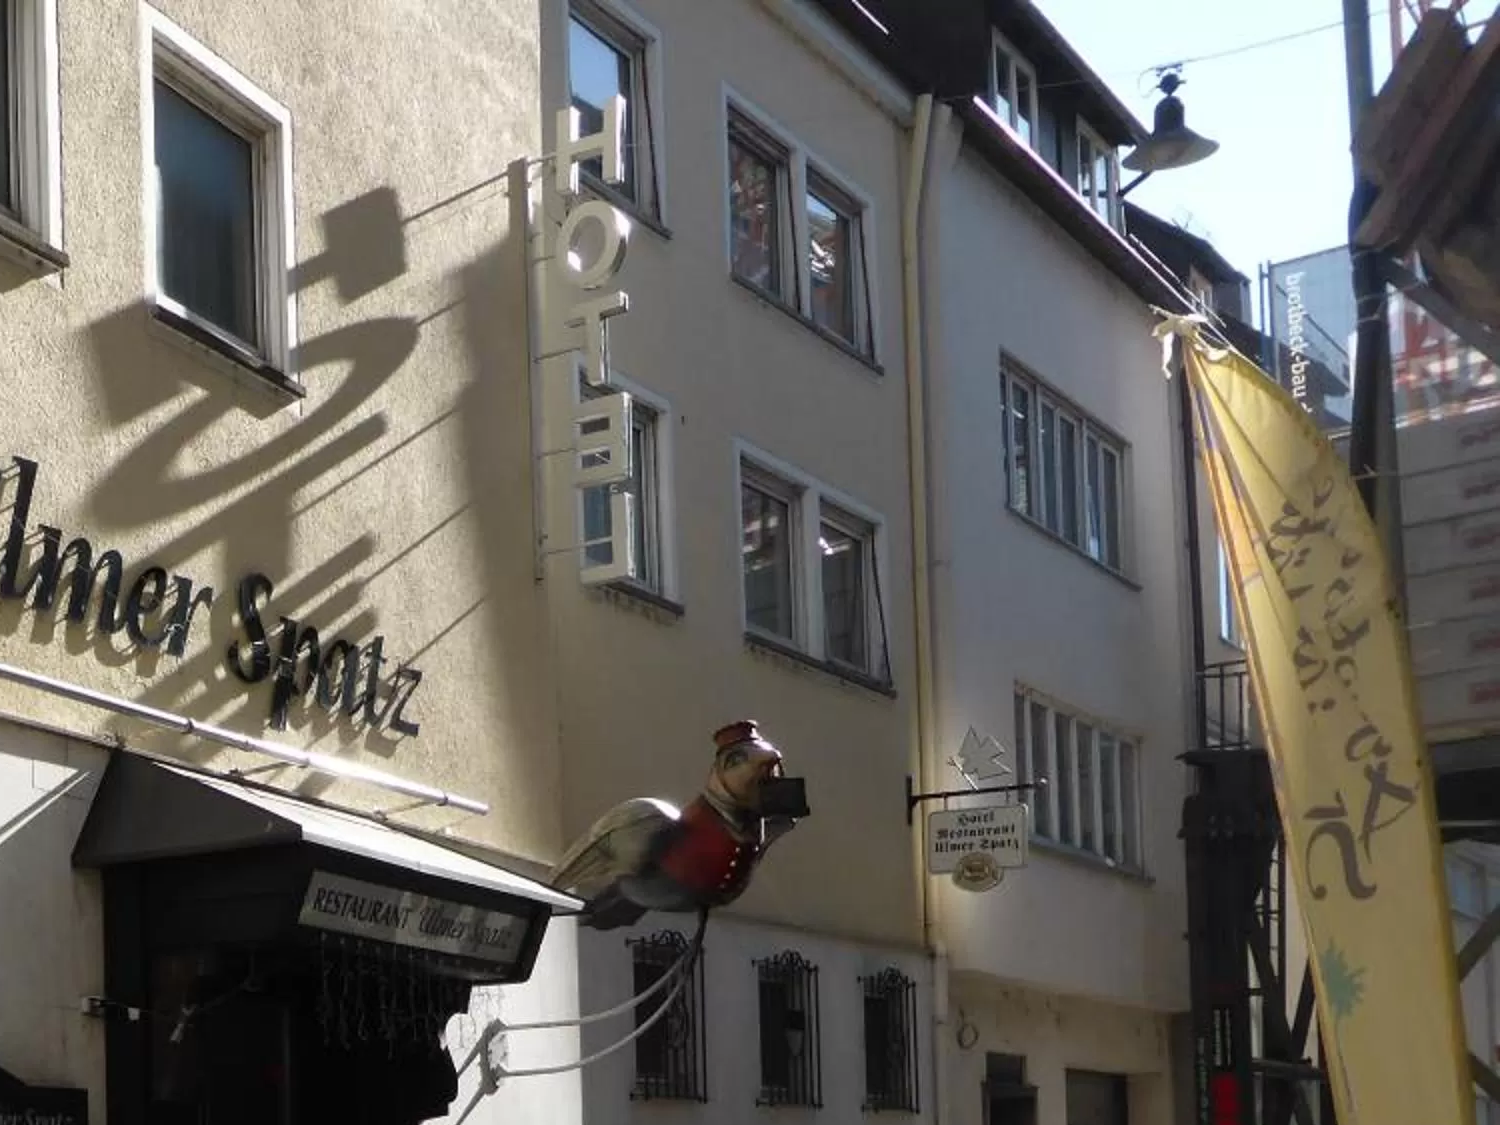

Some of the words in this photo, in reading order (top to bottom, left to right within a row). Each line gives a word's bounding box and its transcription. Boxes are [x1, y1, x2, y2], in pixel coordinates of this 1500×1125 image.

[1286, 272, 1313, 413] brotbeck-bau
[227, 573, 423, 737] Spatz
[313, 887, 412, 929] RESTAURANT
